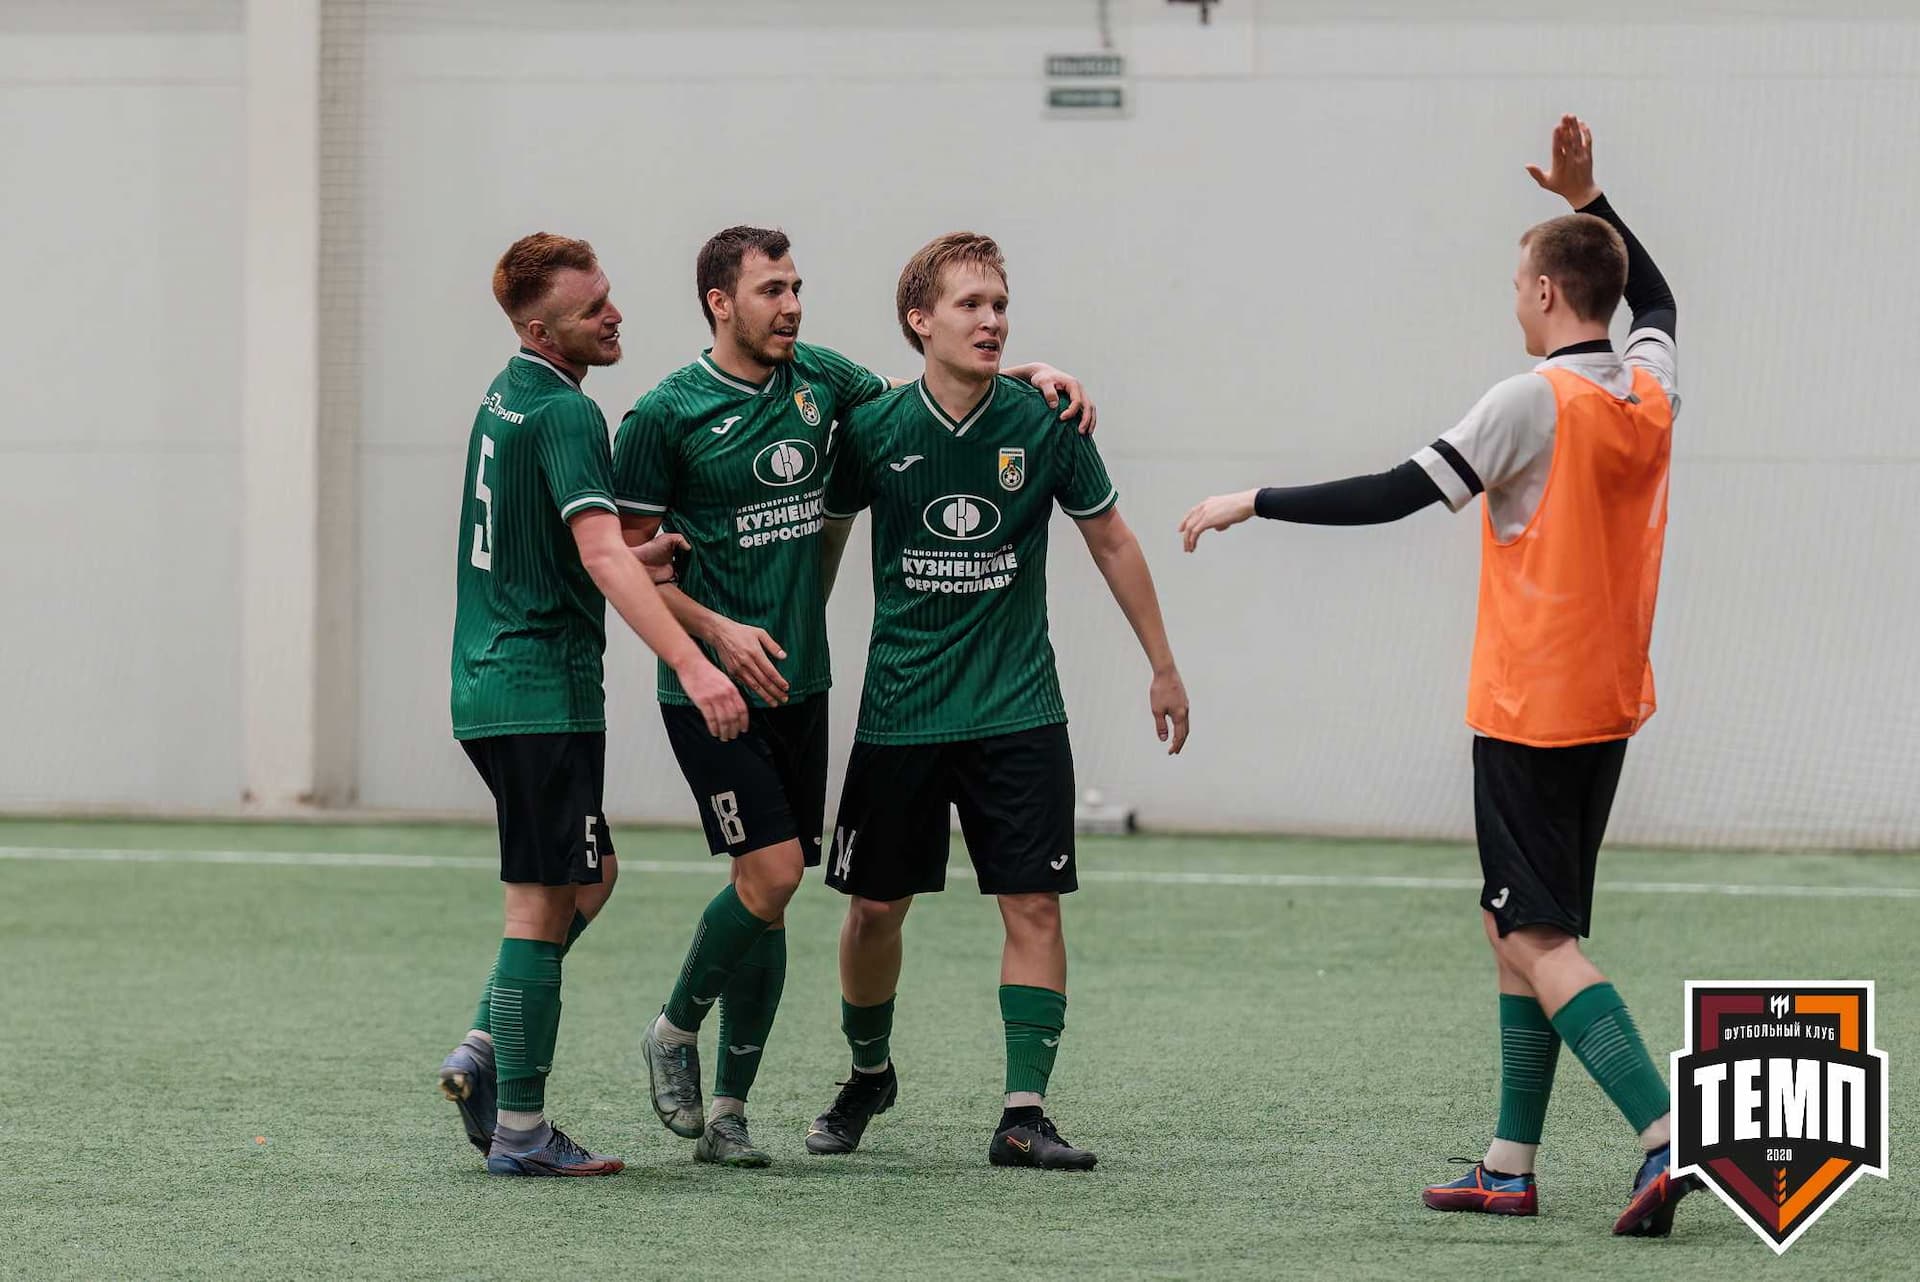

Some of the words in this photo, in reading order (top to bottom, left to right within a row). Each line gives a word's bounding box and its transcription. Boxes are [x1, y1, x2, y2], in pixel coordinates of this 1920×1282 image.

[471, 434, 493, 572] 5
[736, 494, 800, 514] АКЦИОНЕРНОЕ
[902, 552, 1018, 580] КУЗНЕЦКИЕ
[903, 547, 969, 558] АКЦИОНЕРНОЕ
[585, 815, 598, 869] 5
[710, 790, 746, 846] 18
[834, 826, 856, 881] 14
